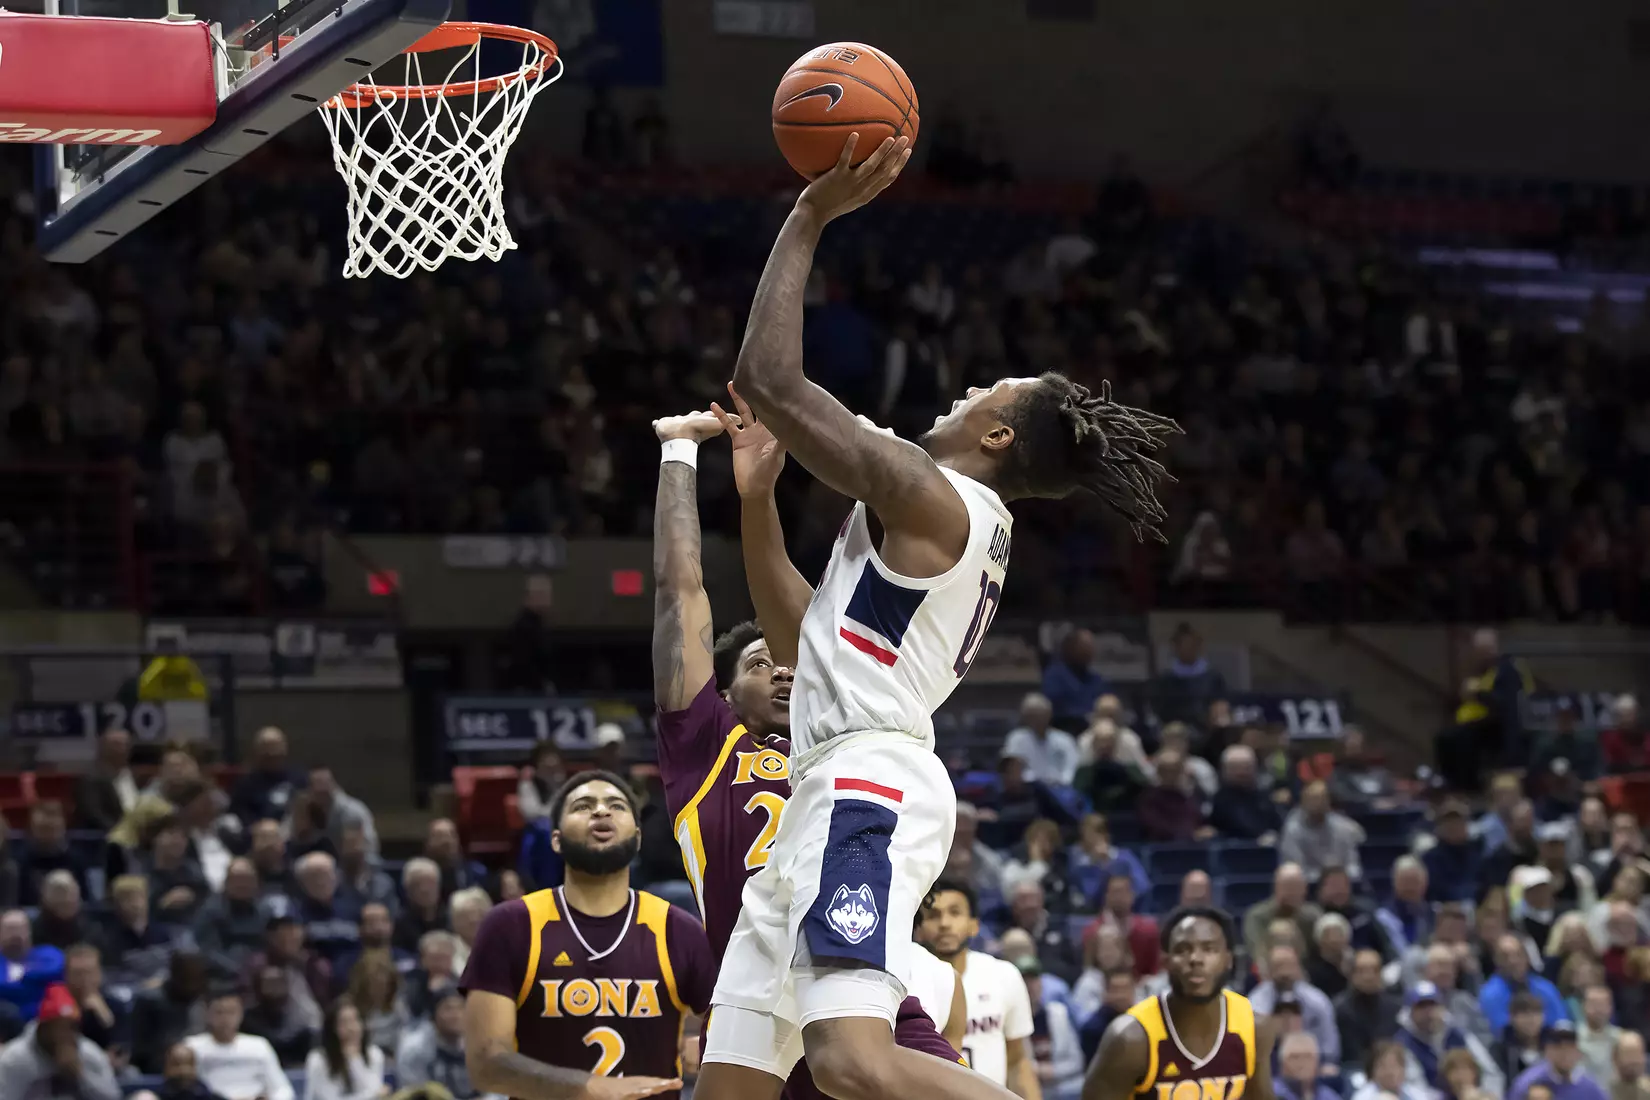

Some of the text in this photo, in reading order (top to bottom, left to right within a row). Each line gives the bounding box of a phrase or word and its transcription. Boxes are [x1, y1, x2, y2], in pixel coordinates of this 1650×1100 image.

[528, 706, 597, 746] 121
[1279, 699, 1345, 738] 121
[731, 748, 789, 786] IO
[539, 978, 663, 1018] IONA
[582, 1026, 626, 1080] 2
